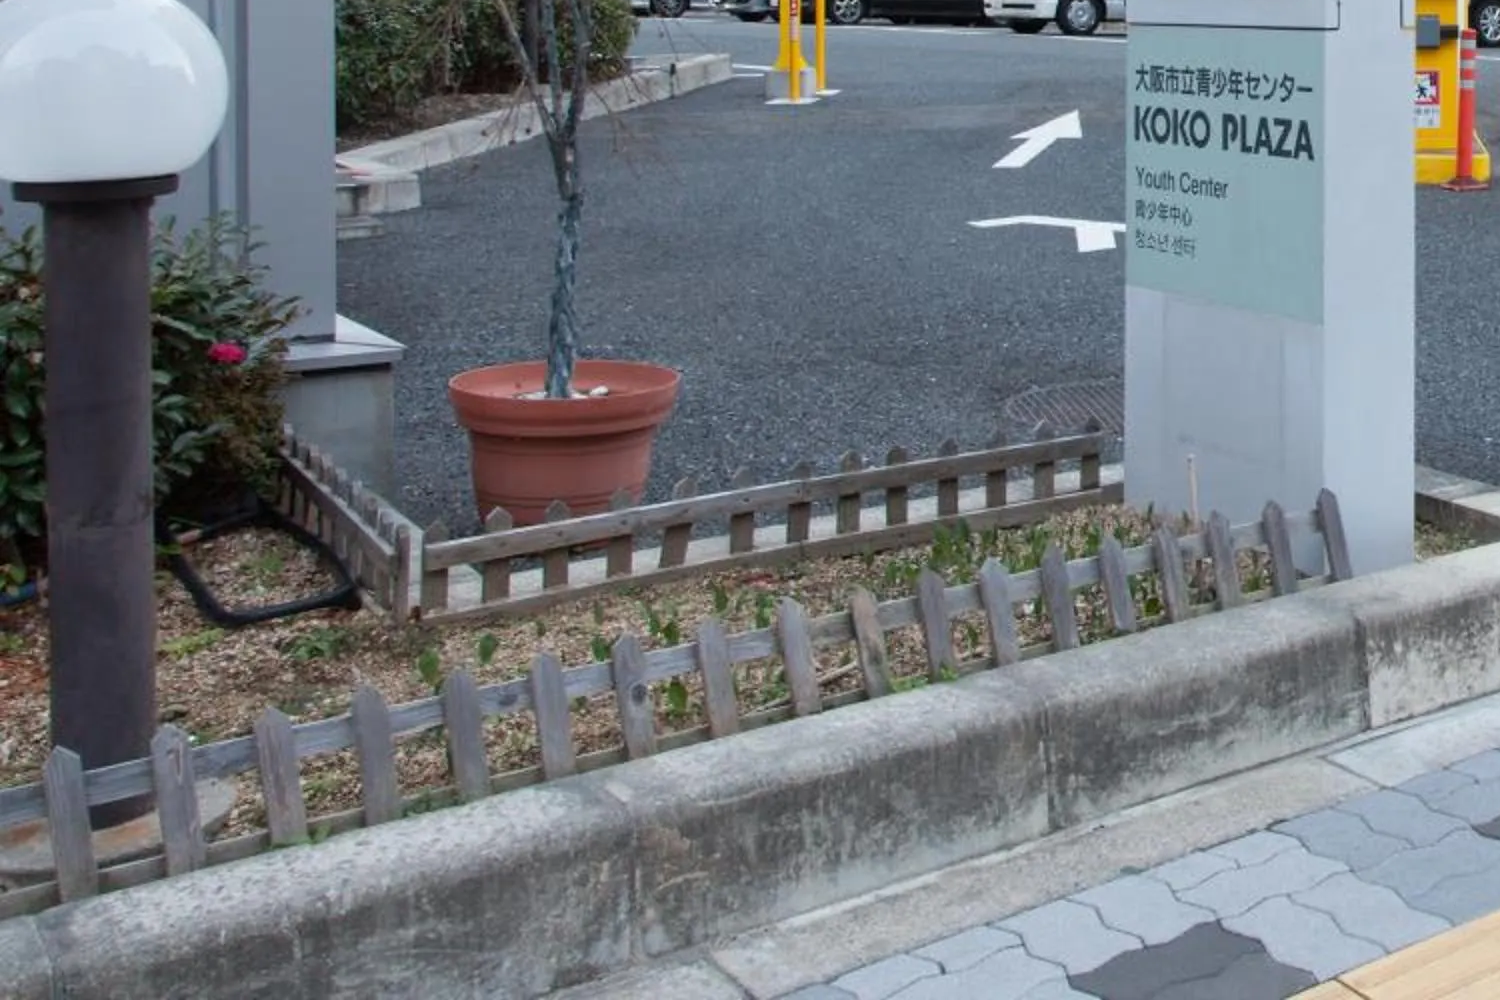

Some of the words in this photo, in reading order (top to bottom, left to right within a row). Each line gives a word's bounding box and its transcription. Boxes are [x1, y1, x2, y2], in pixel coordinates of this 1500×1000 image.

[1135, 64, 1313, 103] 大阪市立青少年センター
[1133, 104, 1211, 149] KOKO
[1221, 112, 1315, 162] PLAZA
[1135, 166, 1175, 194] Youth
[1179, 171, 1229, 199] Center
